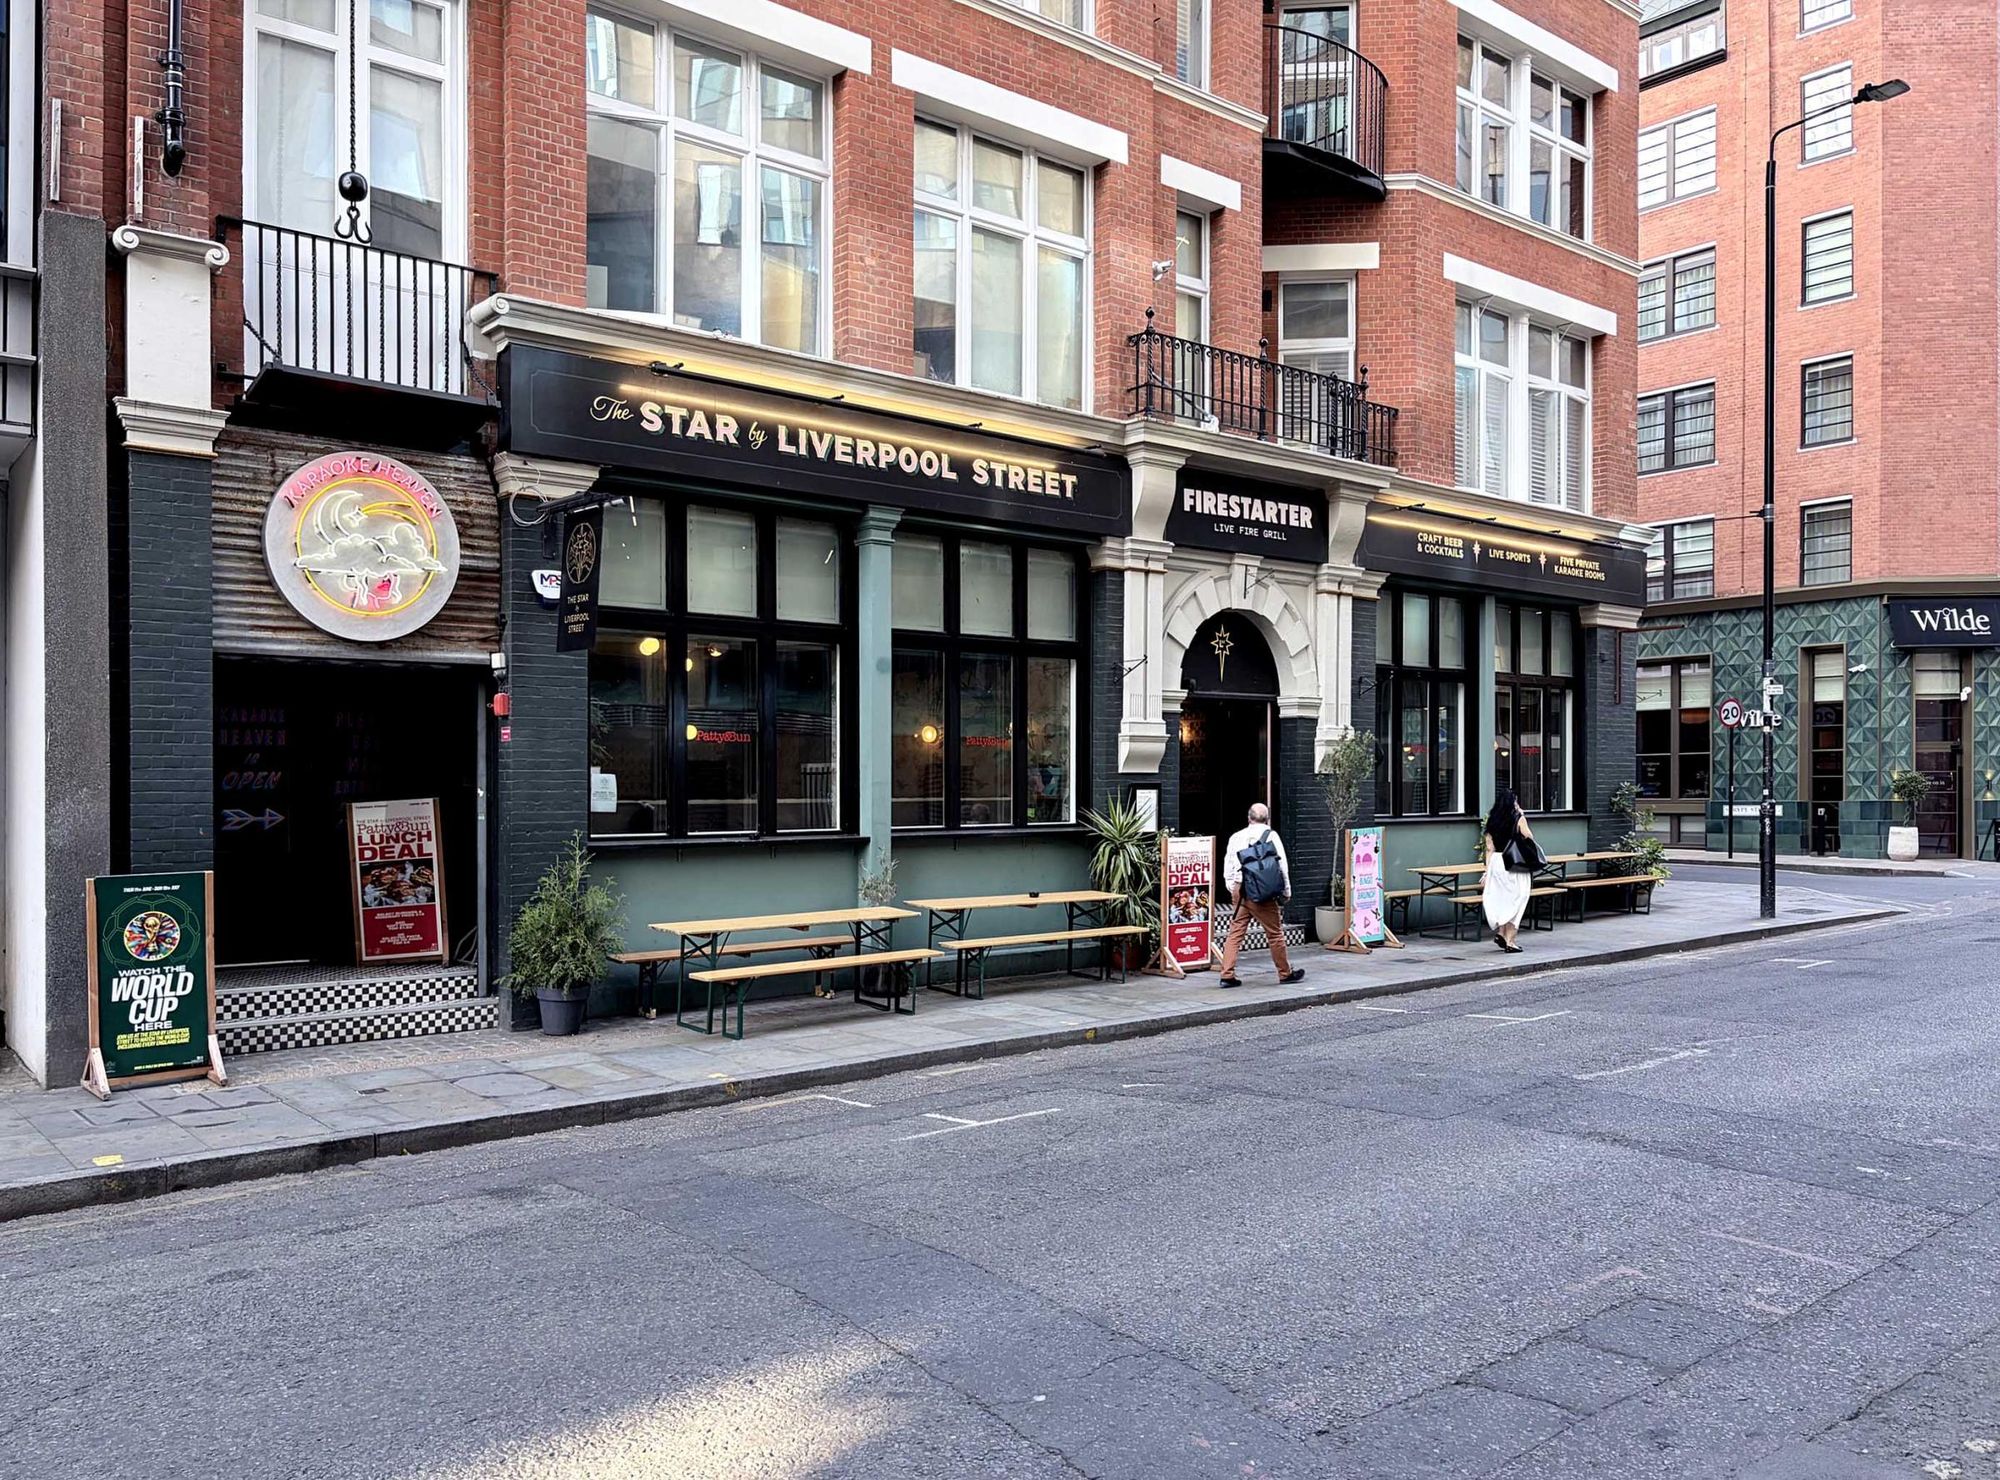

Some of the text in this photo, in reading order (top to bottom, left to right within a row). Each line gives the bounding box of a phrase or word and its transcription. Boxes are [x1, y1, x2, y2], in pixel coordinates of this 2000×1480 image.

[590, 396, 1078, 499] The STAR by LIVERPOOL STREET
[285, 457, 443, 519] KARAOKE HEAVEN
[1183, 488, 1313, 529] FIRESTARTER
[1214, 523, 1287, 541] LIVE FIRE GRILL
[1417, 532, 1464, 549] CRAFT BEER
[1417, 543, 1464, 559] & COCKTAILS
[1488, 549, 1532, 563] LIVE SPORTS
[1560, 556, 1600, 570] FIVE PRIVATE
[1554, 565, 1606, 581] KARAOKE ROOMS
[567, 593, 590, 604] THE STAR
[564, 612, 590, 623] LIVERPOOL
[1910, 607, 1991, 632] Wilde
[568, 623, 585, 633] STREET
[1722, 706, 1739, 720] 20
[222, 771, 282, 790] OPEN
[357, 830, 432, 846] LUNCH
[358, 843, 433, 861] DEAL
[1169, 862, 1210, 874] LUNCH
[1169, 872, 1210, 886] DEAL
[118, 965, 186, 977] WATCH THE
[111, 972, 194, 1002] WORLD
[128, 996, 179, 1024] CUP
[134, 1020, 173, 1032] HERE
